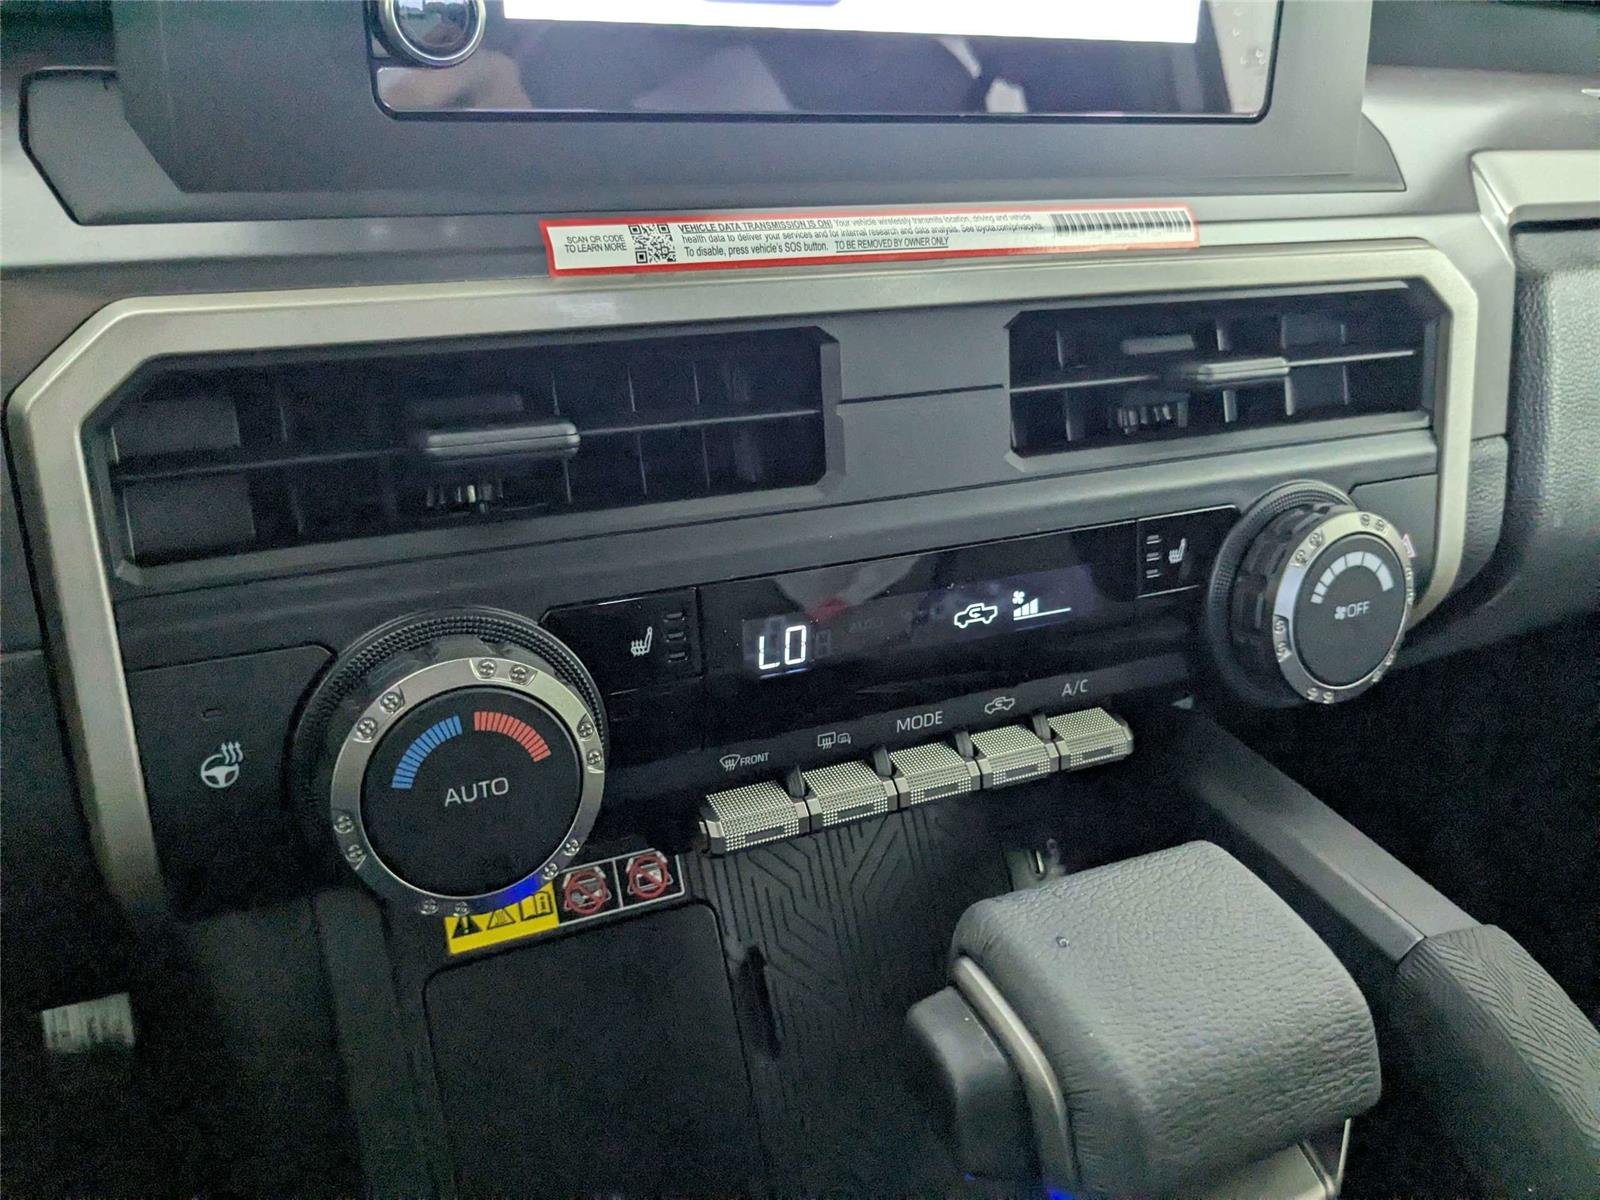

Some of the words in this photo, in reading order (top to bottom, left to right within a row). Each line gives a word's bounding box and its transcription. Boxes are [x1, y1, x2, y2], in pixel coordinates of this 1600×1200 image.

[678, 223, 718, 233] VEHICLE
[718, 222, 743, 231] DATA
[743, 220, 807, 231] TRANSMISSION
[808, 219, 817, 228] IS
[836, 219, 850, 227] Your
[853, 218, 877, 226] vehicle
[880, 216, 911, 226] wirelessly
[566, 235, 588, 244] SCAN
[602, 234, 625, 243] CODE
[682, 234, 707, 244] health
[708, 233, 726, 242] data
[728, 233, 736, 242] to
[737, 231, 762, 241] deliver
[764, 231, 781, 242] your
[782, 230, 813, 240] services
[814, 229, 828, 239] and
[829, 229, 840, 238] for
[841, 228, 867, 237] internal
[868, 227, 899, 236] research
[900, 227, 913, 235] and
[915, 226, 930, 234] data
[961, 224, 975, 233] See
[564, 244, 576, 253] TO
[577, 243, 603, 253] LEARN
[604, 242, 627, 252] MORE
[684, 246, 695, 257] To
[696, 245, 727, 257] disable,
[728, 244, 749, 257] press
[751, 242, 783, 254] vehicle's
[784, 241, 802, 252] SOS
[803, 240, 829, 251] button.
[835, 240, 845, 250] TO
[846, 240, 857, 249] BE
[857, 238, 893, 249] REMOVED
[893, 238, 903, 247] BY
[904, 237, 930, 247] OWNER
[931, 236, 949, 246] ONLY
[1346, 601, 1370, 617] OFF
[1061, 678, 1090, 698] A/C
[896, 710, 944, 733] MODE
[739, 752, 770, 768] FRONT
[444, 776, 510, 808] AUTO
